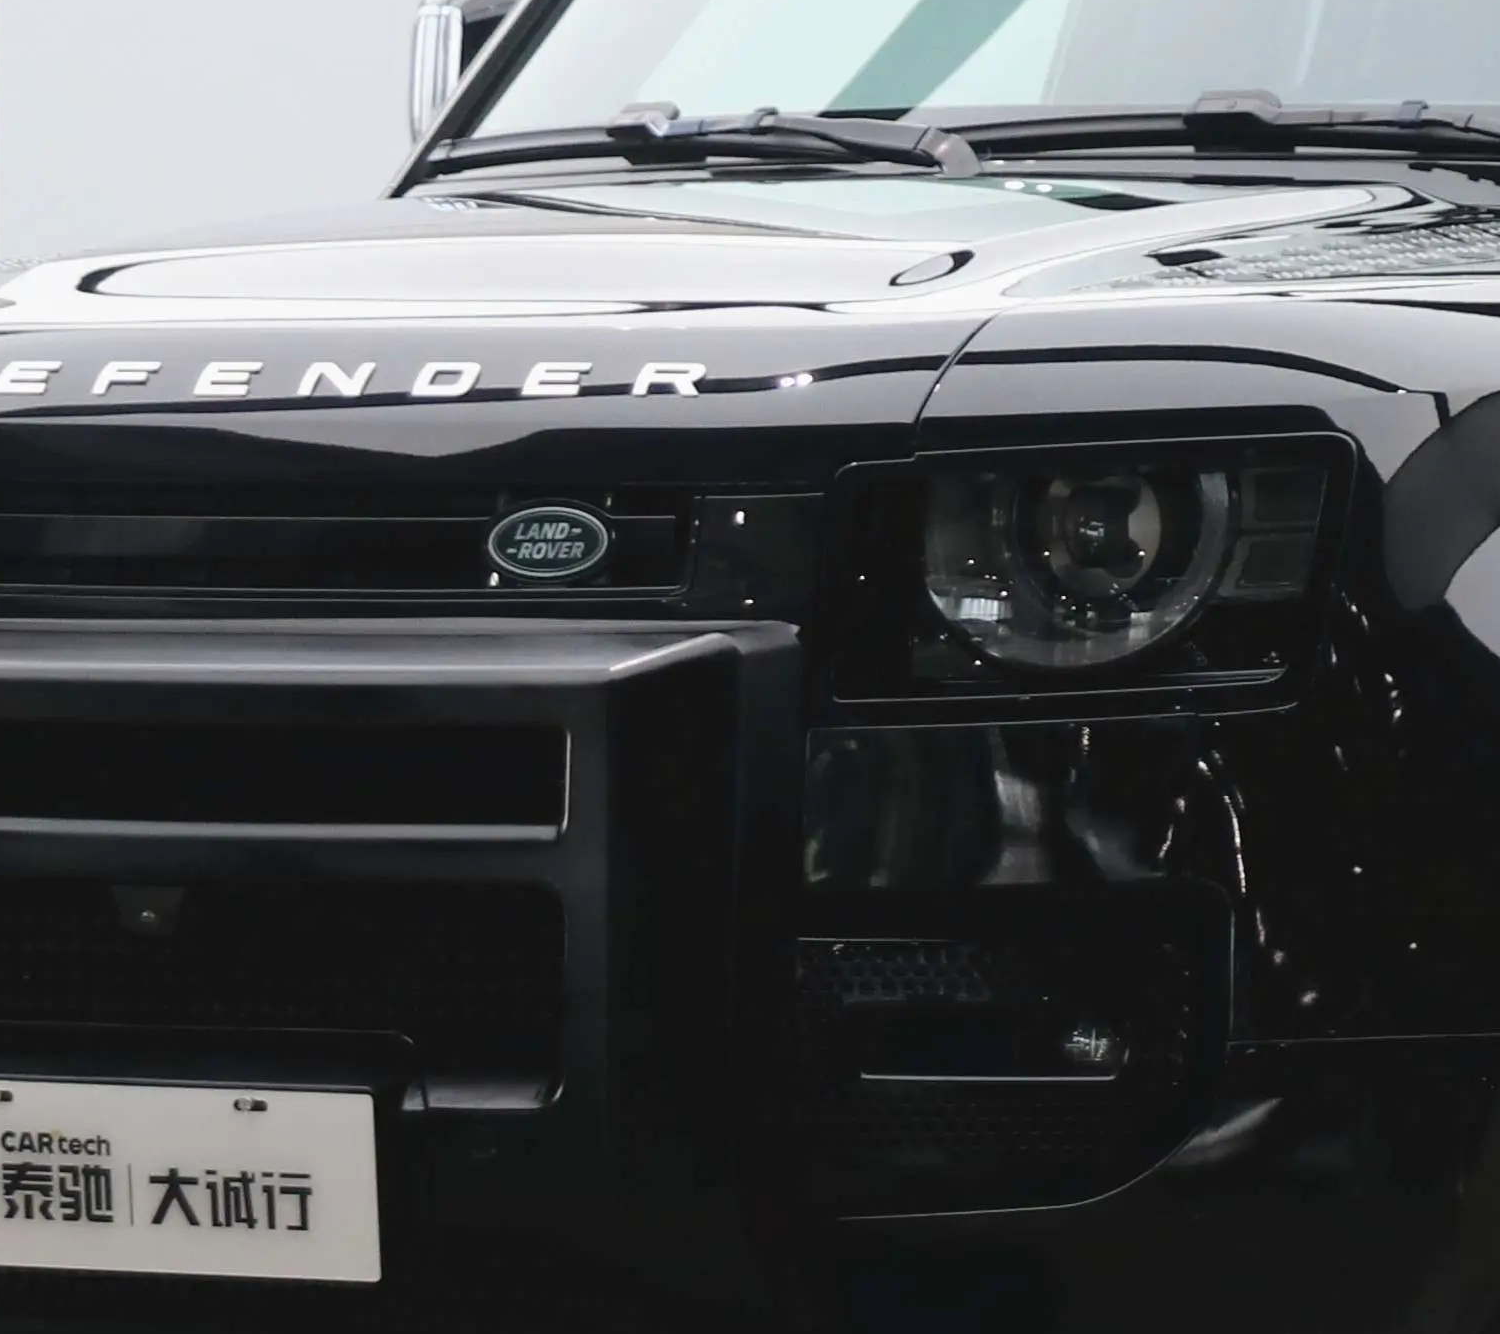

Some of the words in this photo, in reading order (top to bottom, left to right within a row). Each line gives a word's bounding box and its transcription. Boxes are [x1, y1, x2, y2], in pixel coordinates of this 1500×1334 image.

[0, 1129, 111, 1157] CARtech
[148, 1166, 314, 1233] 大诚行
